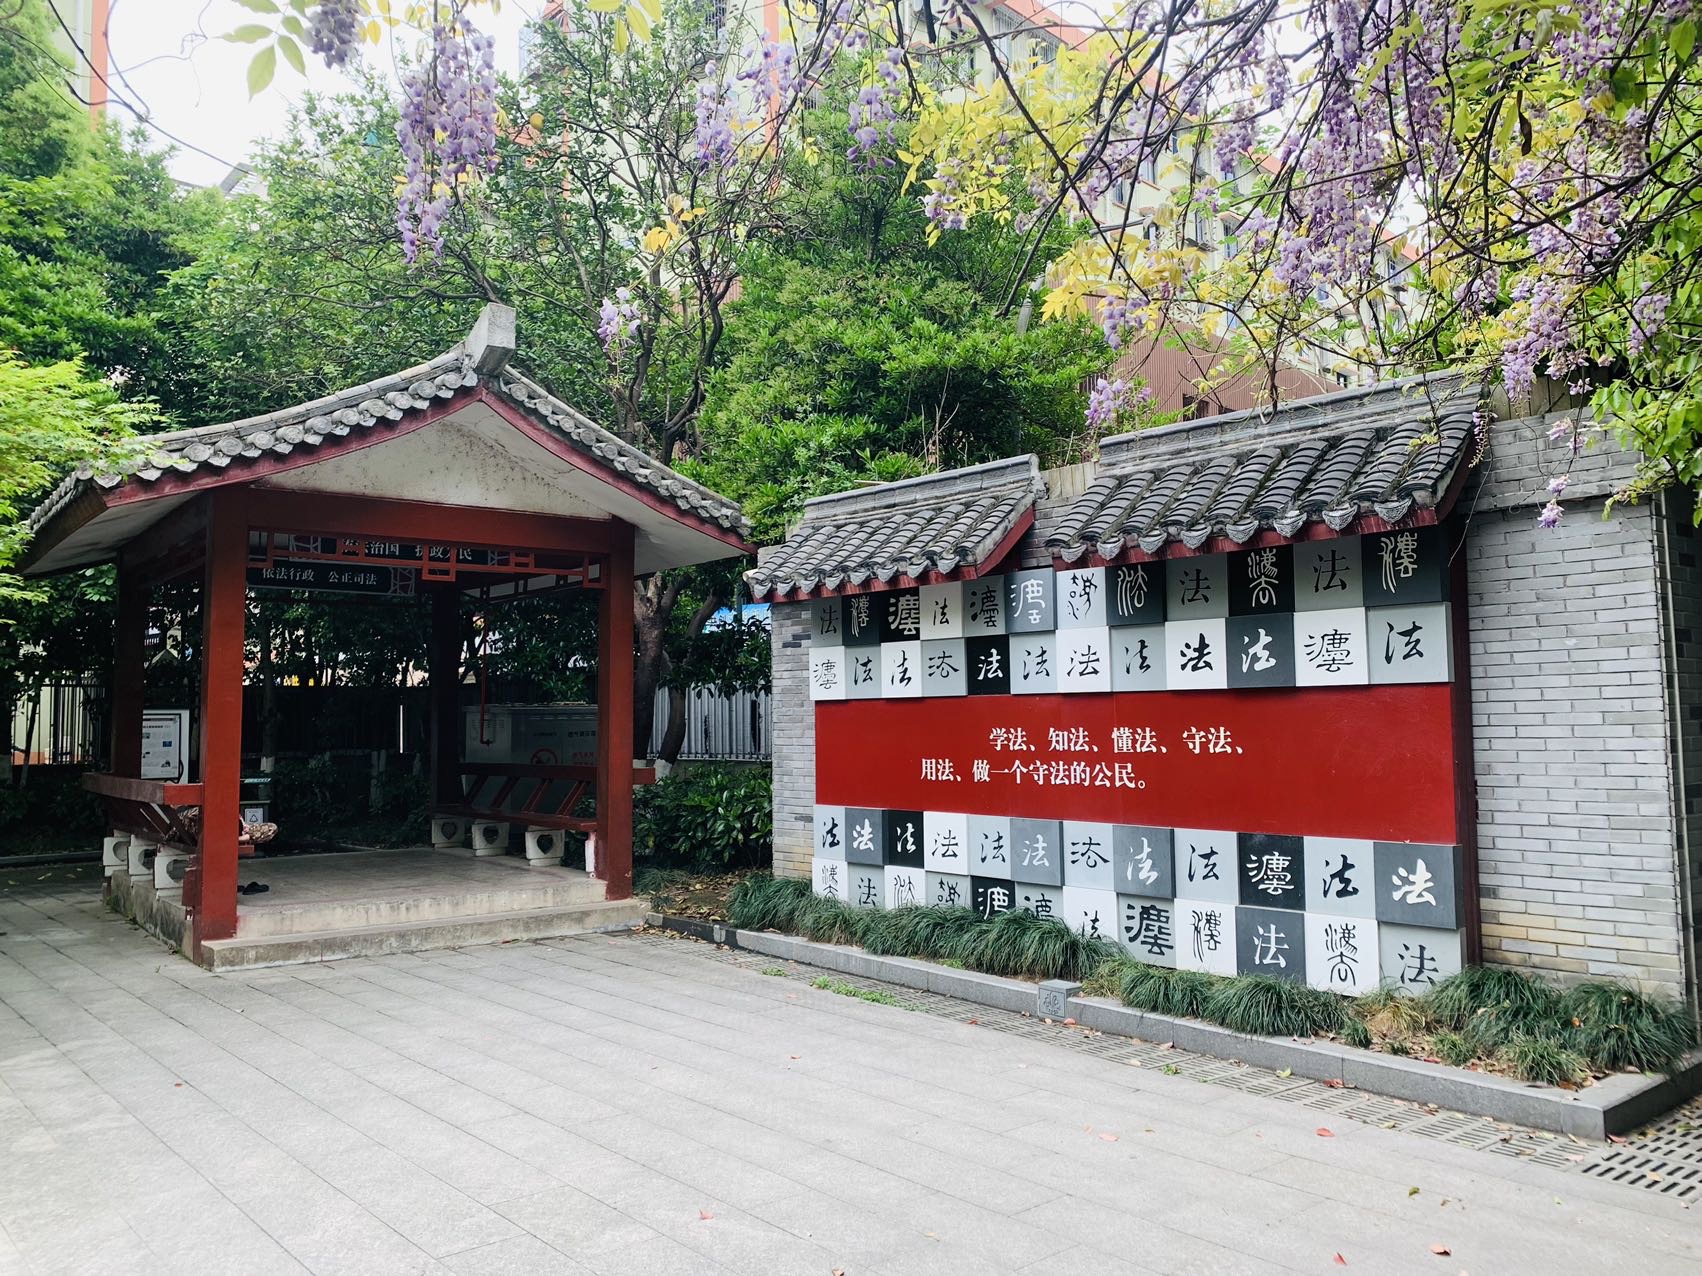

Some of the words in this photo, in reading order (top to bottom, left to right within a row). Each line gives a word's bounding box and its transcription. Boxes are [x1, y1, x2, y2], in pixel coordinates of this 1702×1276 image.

[262, 567, 315, 581] 依法行政
[328, 571, 378, 585] 公正司法
[820, 605, 839, 635] 法
[933, 598, 950, 625] 法
[1179, 568, 1212, 606] 法
[1313, 549, 1350, 593] 法
[854, 656, 873, 685] 法
[891, 650, 911, 687] 法
[977, 648, 1004, 680] 法
[1022, 646, 1050, 680] 法
[1067, 644, 1100, 677] 法
[1125, 639, 1151, 675] 法
[1180, 632, 1213, 672] 法
[1241, 628, 1277, 673] 法
[1384, 621, 1424, 665] 法
[822, 817, 840, 848] 法
[852, 818, 874, 851] 法
[896, 822, 916, 854] 法
[932, 829, 958, 859] 法
[980, 831, 1006, 863] 法
[1022, 834, 1050, 867] 法
[1127, 837, 1159, 885] 法
[1187, 844, 1220, 882] 法
[1322, 854, 1360, 899] 法
[1391, 858, 1437, 906] 法
[857, 877, 876, 907] 法
[1081, 910, 1102, 940] 法
[1253, 924, 1289, 968] 法
[1398, 943, 1440, 985] 法
